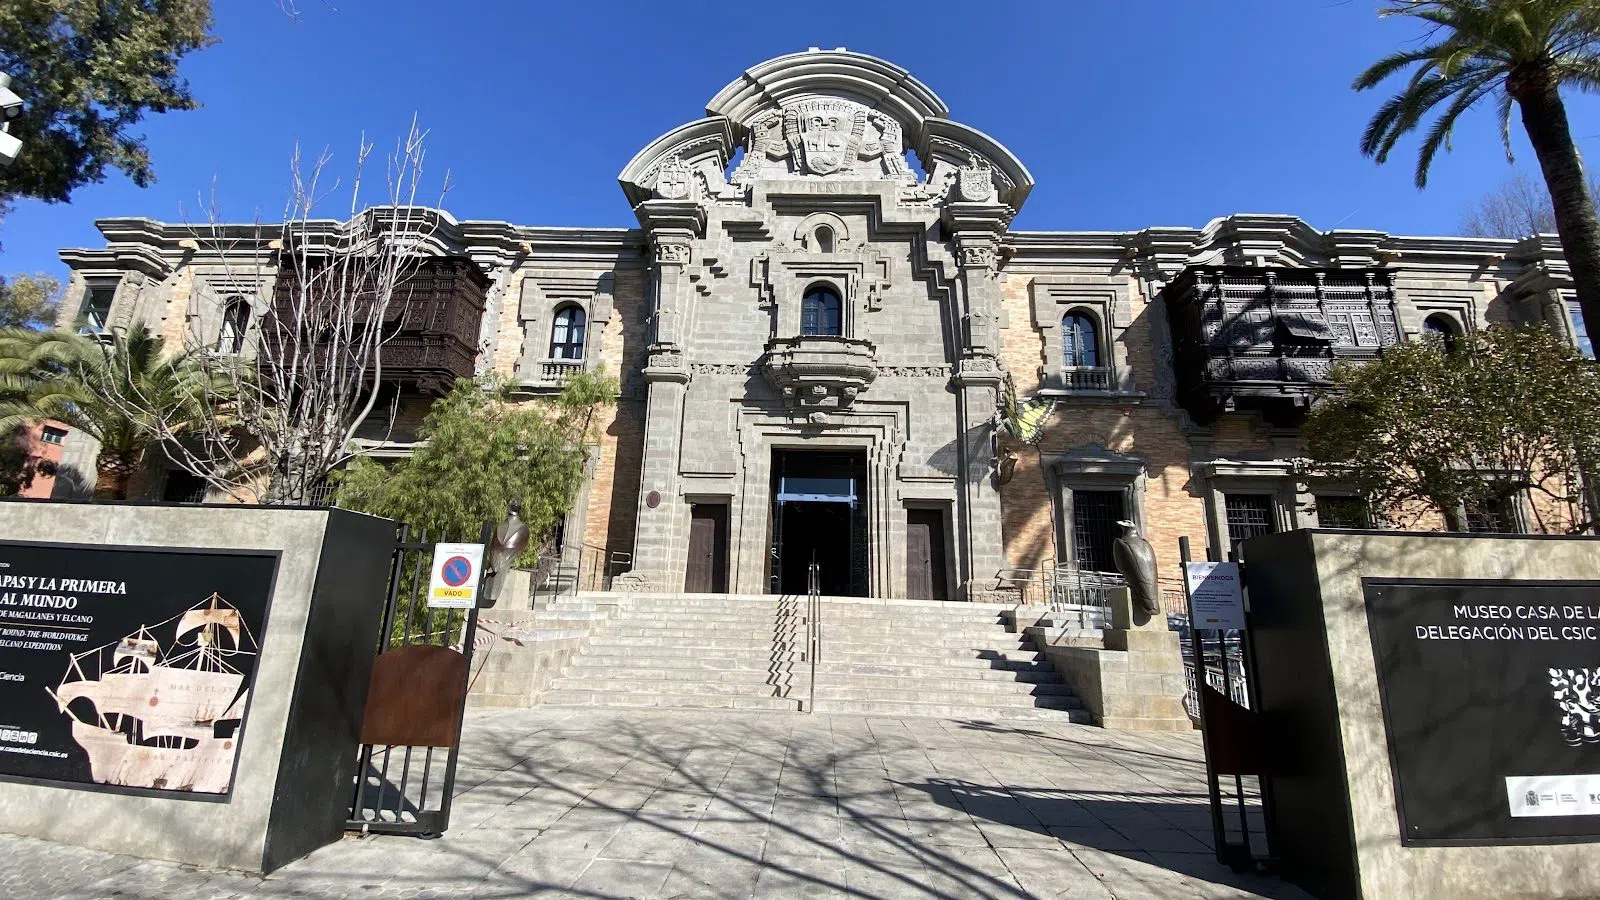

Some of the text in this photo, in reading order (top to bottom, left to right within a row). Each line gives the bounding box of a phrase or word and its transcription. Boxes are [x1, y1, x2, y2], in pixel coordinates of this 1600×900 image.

[38, 577, 56, 591] LA
[59, 578, 127, 594] PRIMERA
[0, 592, 78, 609] AL MUNDO
[8, 610, 55, 621] MAGALLANES
[56, 613, 63, 621] Y
[62, 614, 93, 624] ELCANO
[1453, 605, 1512, 619] MUSEO
[1516, 605, 1560, 619] CASA
[1563, 605, 1585, 619] DE
[1415, 623, 1597, 640] DELEGACIÓN DEL CSIC
[23, 641, 63, 651] EXPEDITION
